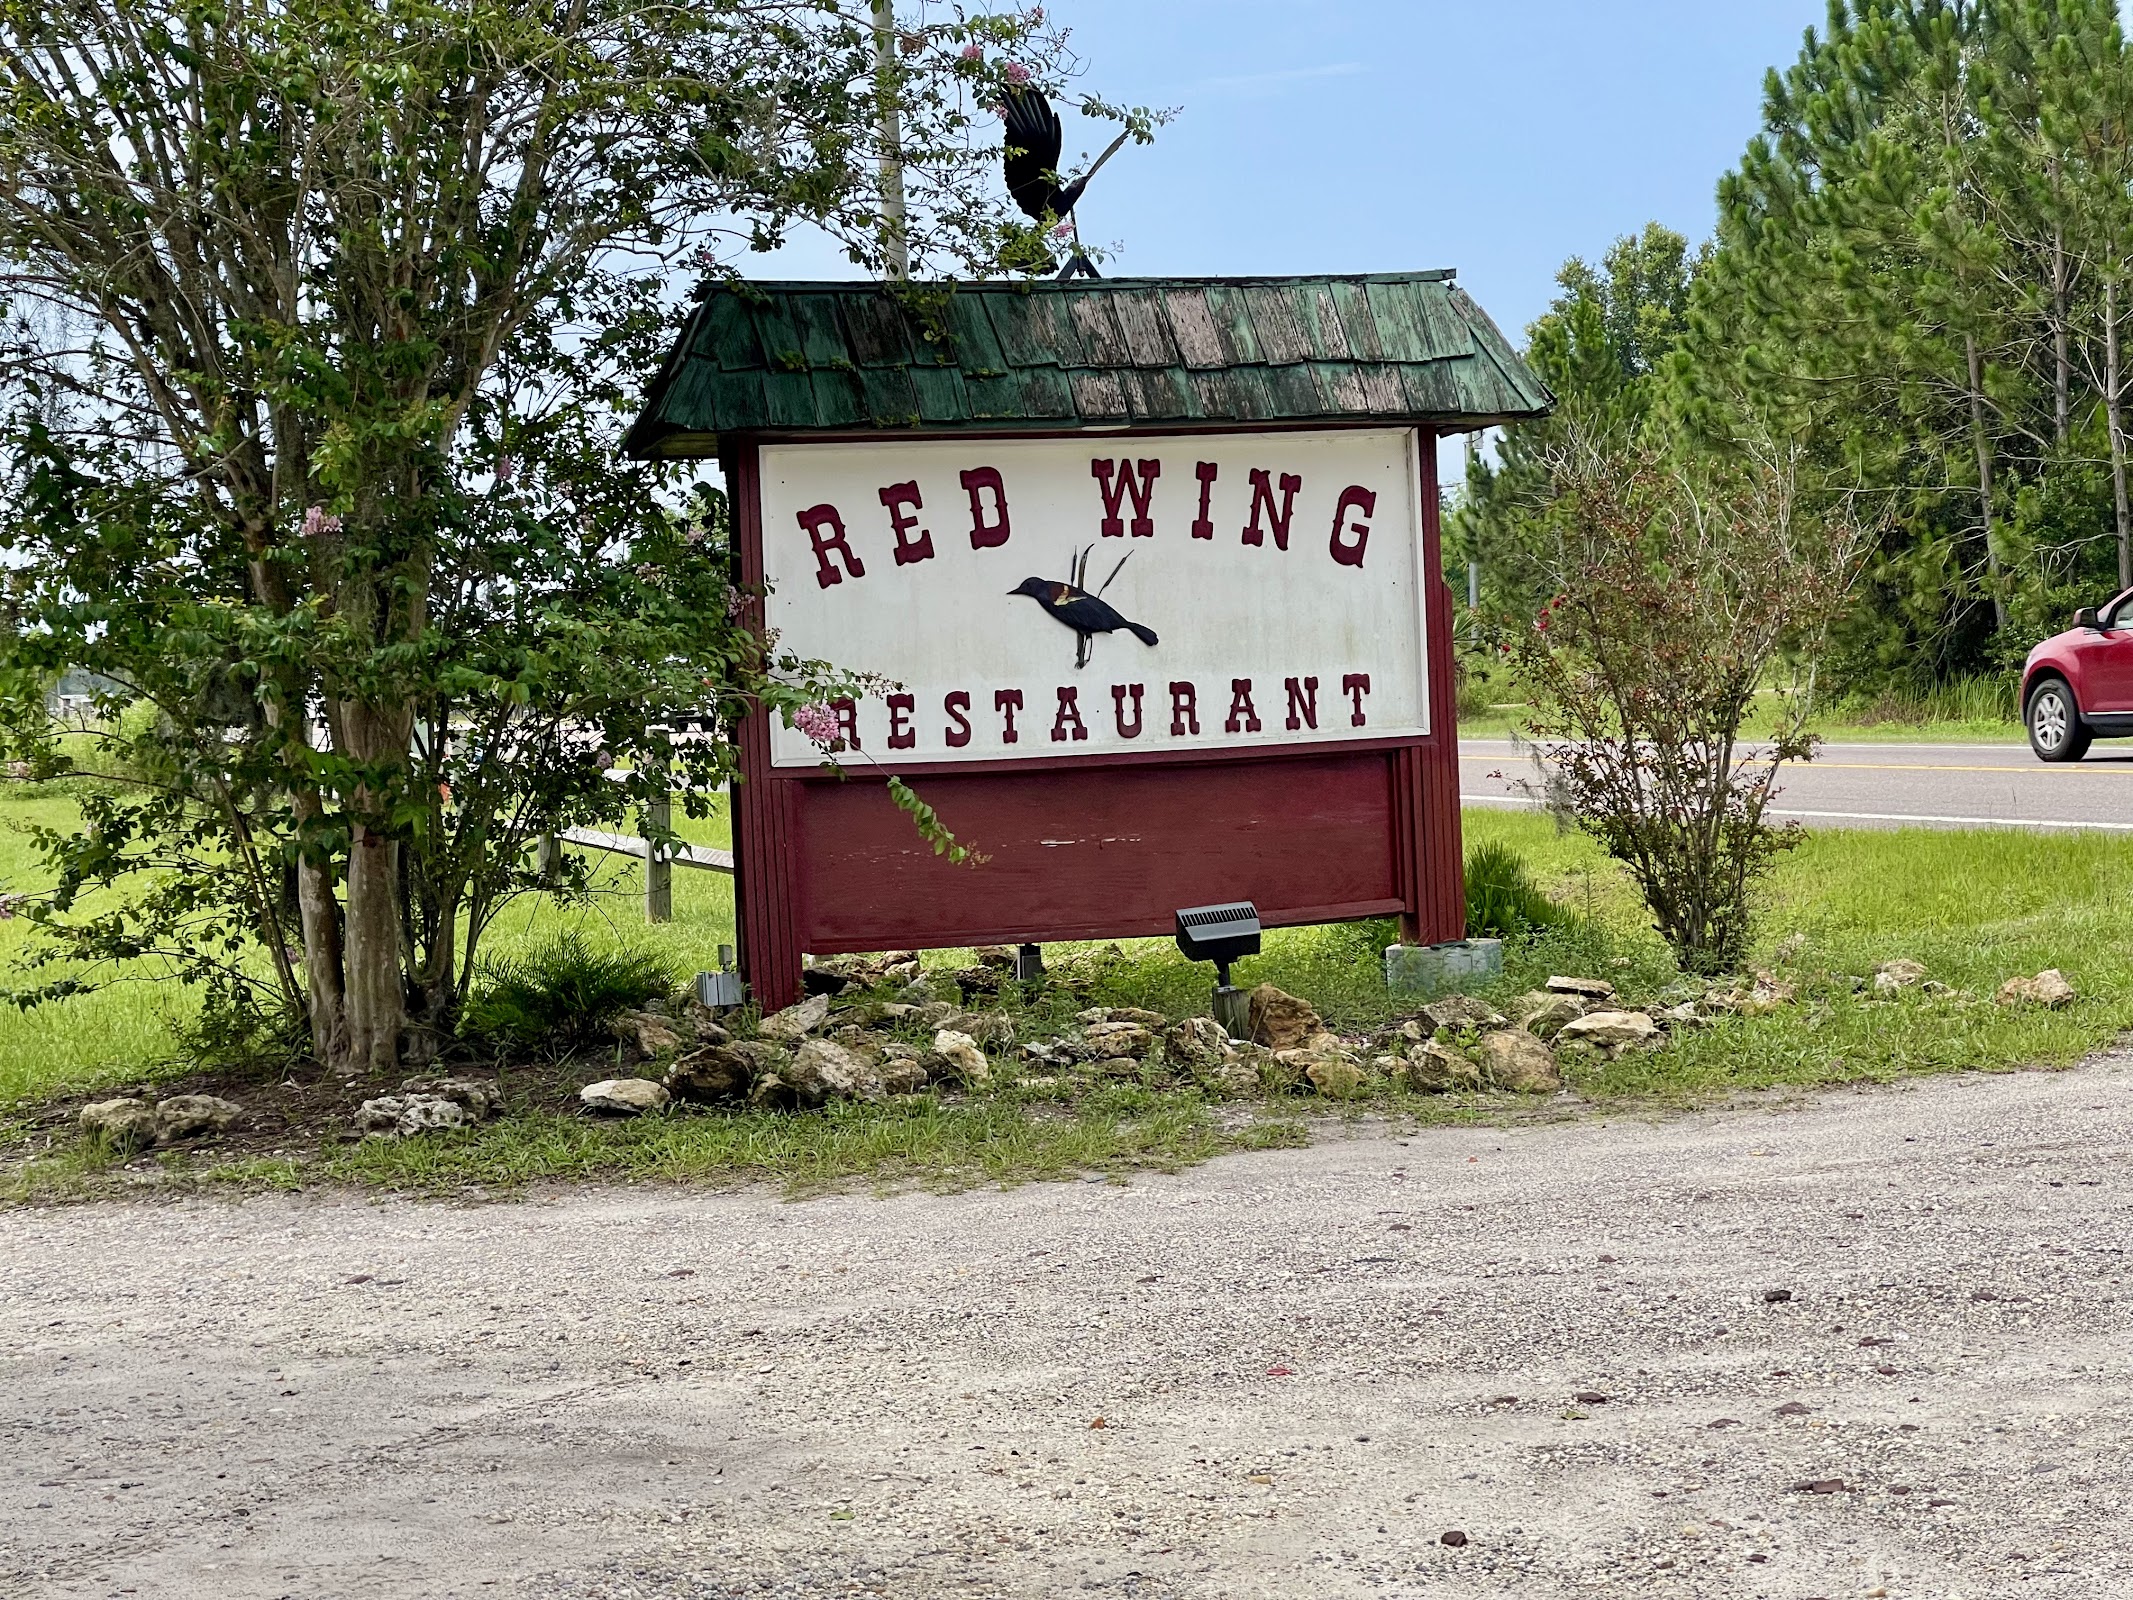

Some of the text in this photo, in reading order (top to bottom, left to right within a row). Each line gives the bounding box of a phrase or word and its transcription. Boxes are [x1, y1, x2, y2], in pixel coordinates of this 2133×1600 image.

[797, 458, 1377, 589] RED WING
[830, 673, 1371, 752] RESTAURANT
